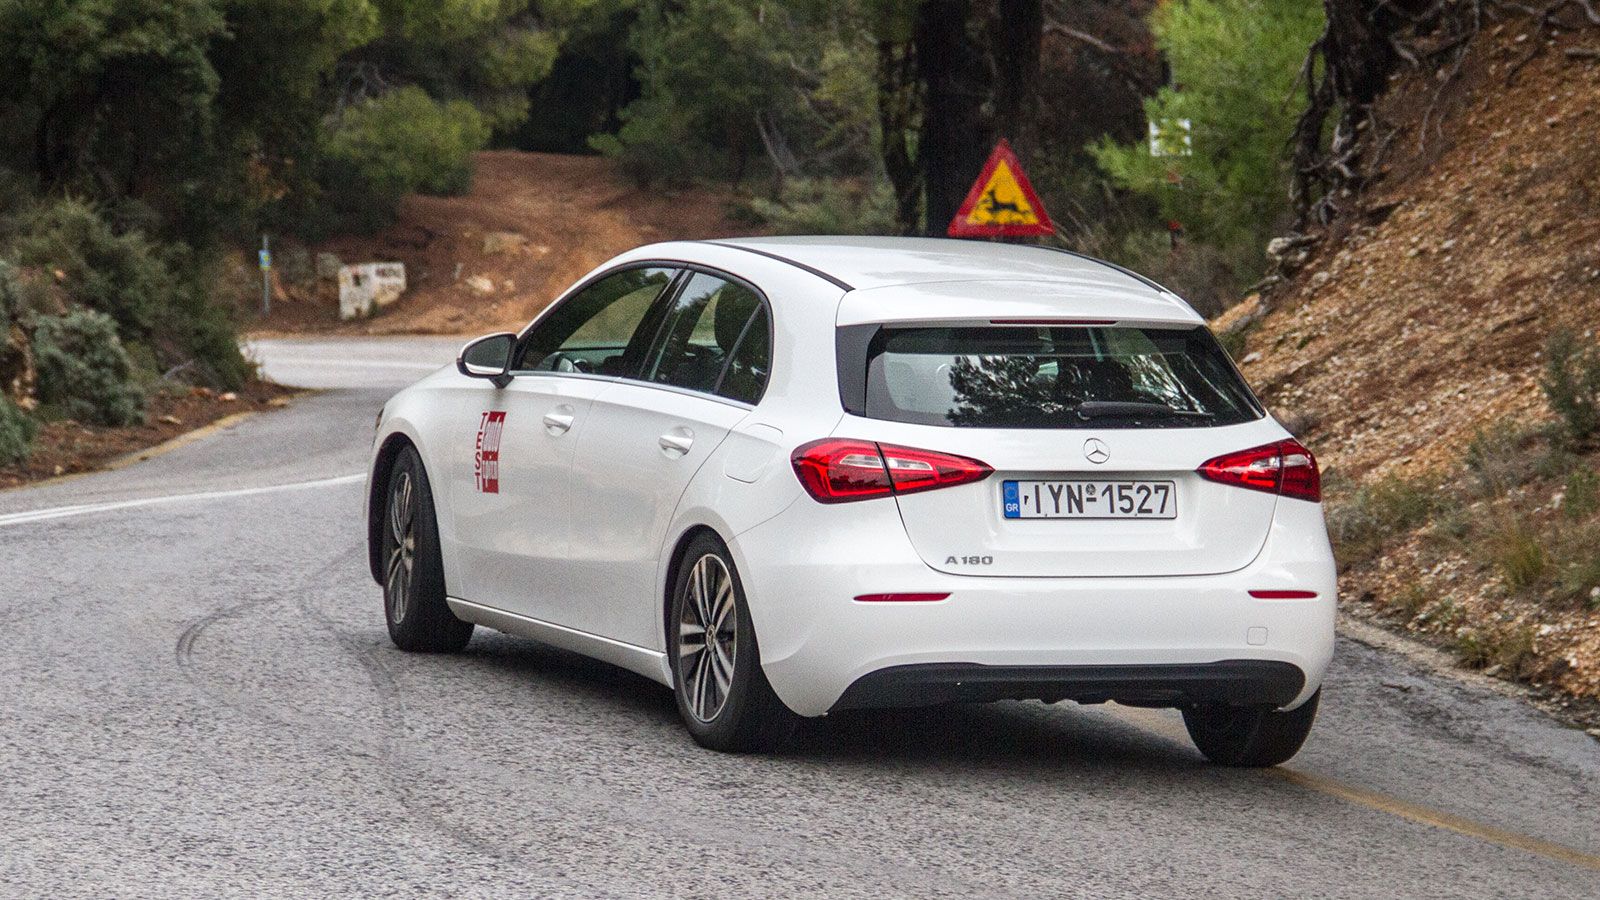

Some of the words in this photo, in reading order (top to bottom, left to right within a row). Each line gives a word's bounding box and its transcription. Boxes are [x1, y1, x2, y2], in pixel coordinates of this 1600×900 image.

[475, 412, 488, 490] TEST
[1005, 503, 1019, 512] GR
[944, 555, 959, 565] A
[961, 555, 994, 565] 180
